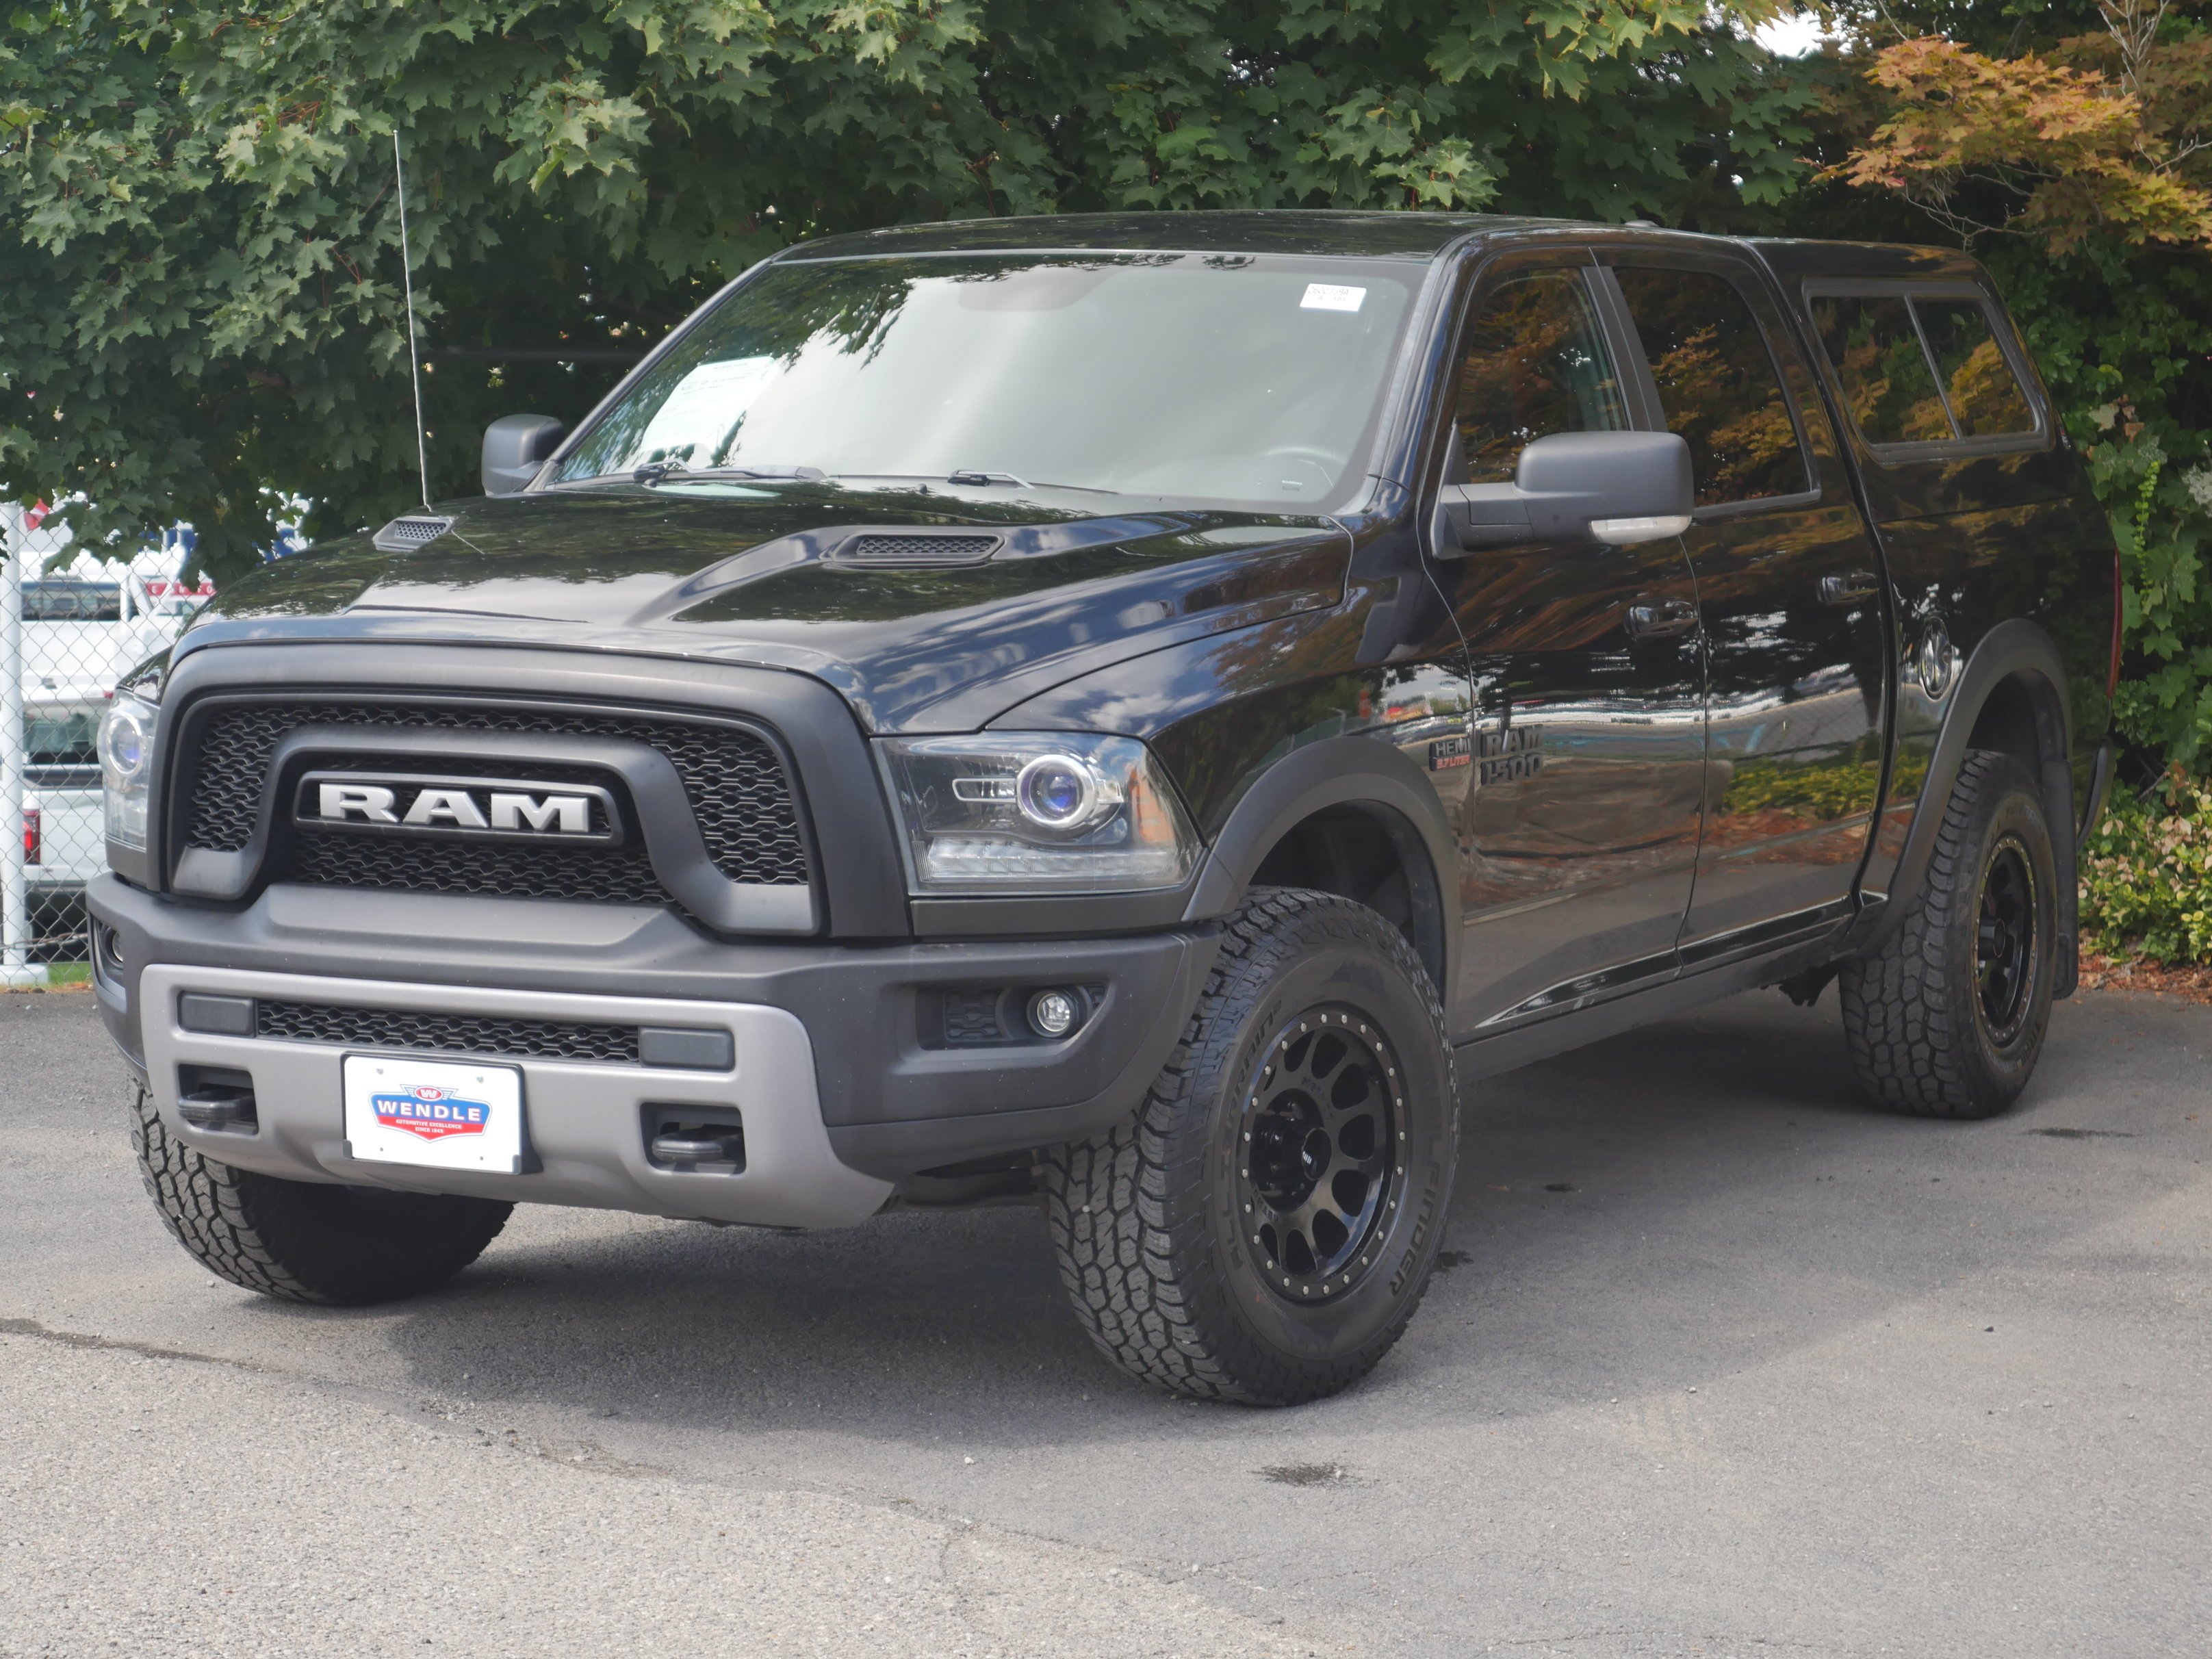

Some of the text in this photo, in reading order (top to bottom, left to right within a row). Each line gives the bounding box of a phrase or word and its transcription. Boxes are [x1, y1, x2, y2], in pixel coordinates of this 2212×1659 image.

[1435, 738, 1471, 756] HEMI
[1481, 723, 1544, 758] RAM
[1481, 752, 1544, 785] 1500
[319, 782, 589, 833] RAM
[420, 1088, 437, 1098] W
[377, 1100, 481, 1121] WENDLE
